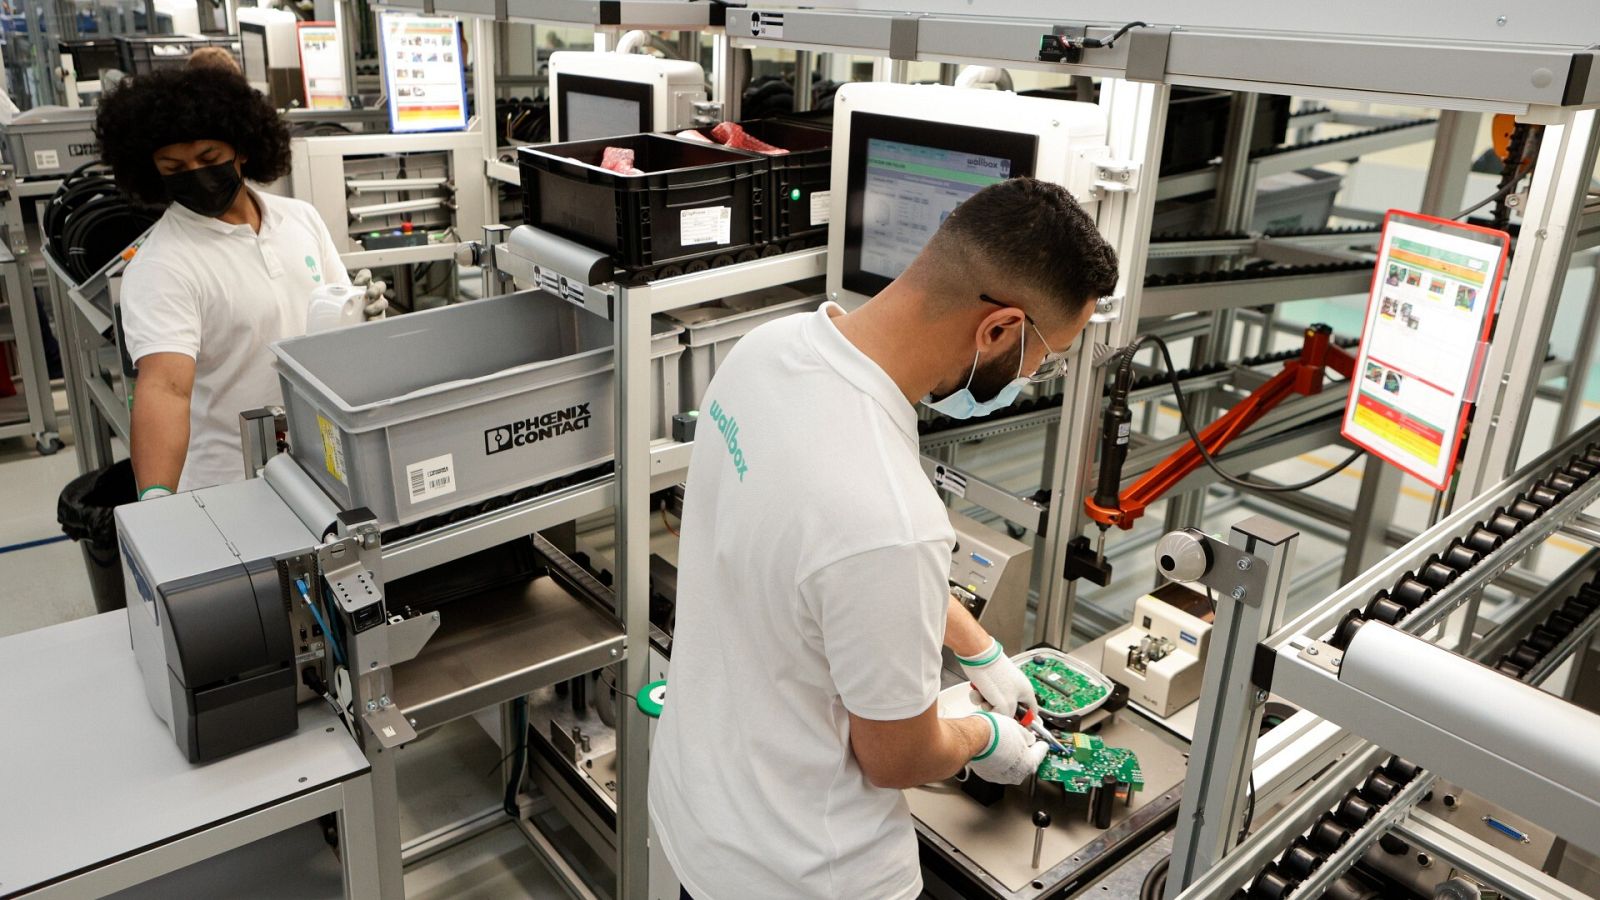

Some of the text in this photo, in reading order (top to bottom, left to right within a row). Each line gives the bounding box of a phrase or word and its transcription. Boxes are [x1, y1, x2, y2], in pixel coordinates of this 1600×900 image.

[966, 157, 999, 169] wallbox
[513, 415, 592, 447] CONTACT
[709, 399, 749, 483] wallbox
